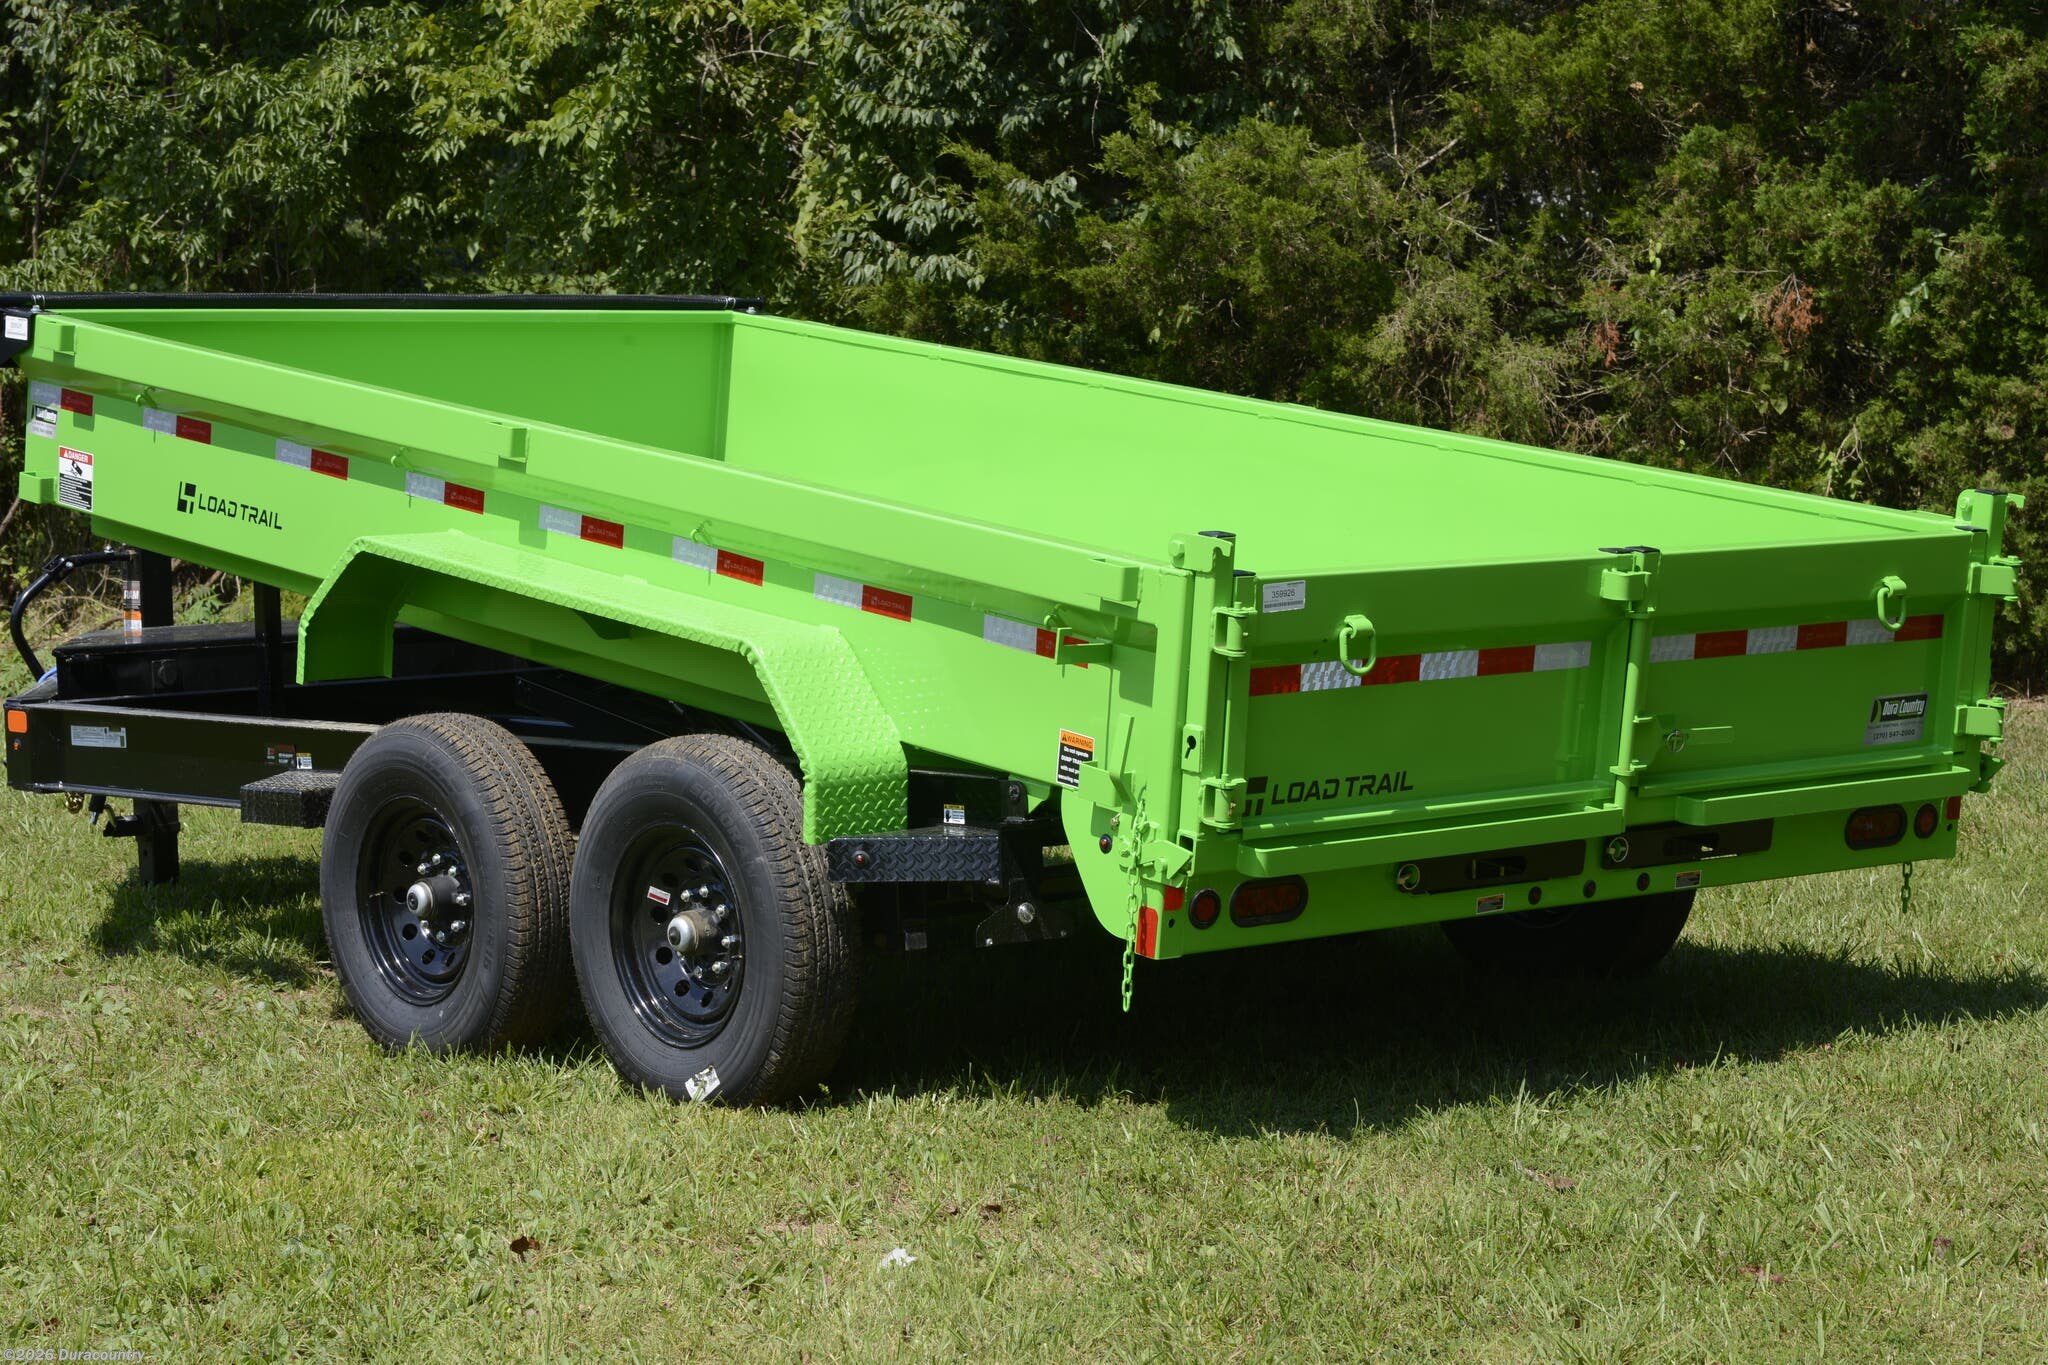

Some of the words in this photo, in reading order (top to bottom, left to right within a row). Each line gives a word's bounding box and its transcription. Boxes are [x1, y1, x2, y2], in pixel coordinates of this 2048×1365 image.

[67, 451, 88, 463] DANGER
[198, 493, 238, 518] LOAD
[240, 504, 282, 530] TRAIL
[1882, 701, 1899, 716] Dura
[1899, 699, 1926, 715] Country
[1067, 735, 1093, 749] WARNING
[1271, 778, 1340, 805] LOAD
[1344, 771, 1414, 797] TRAIL
